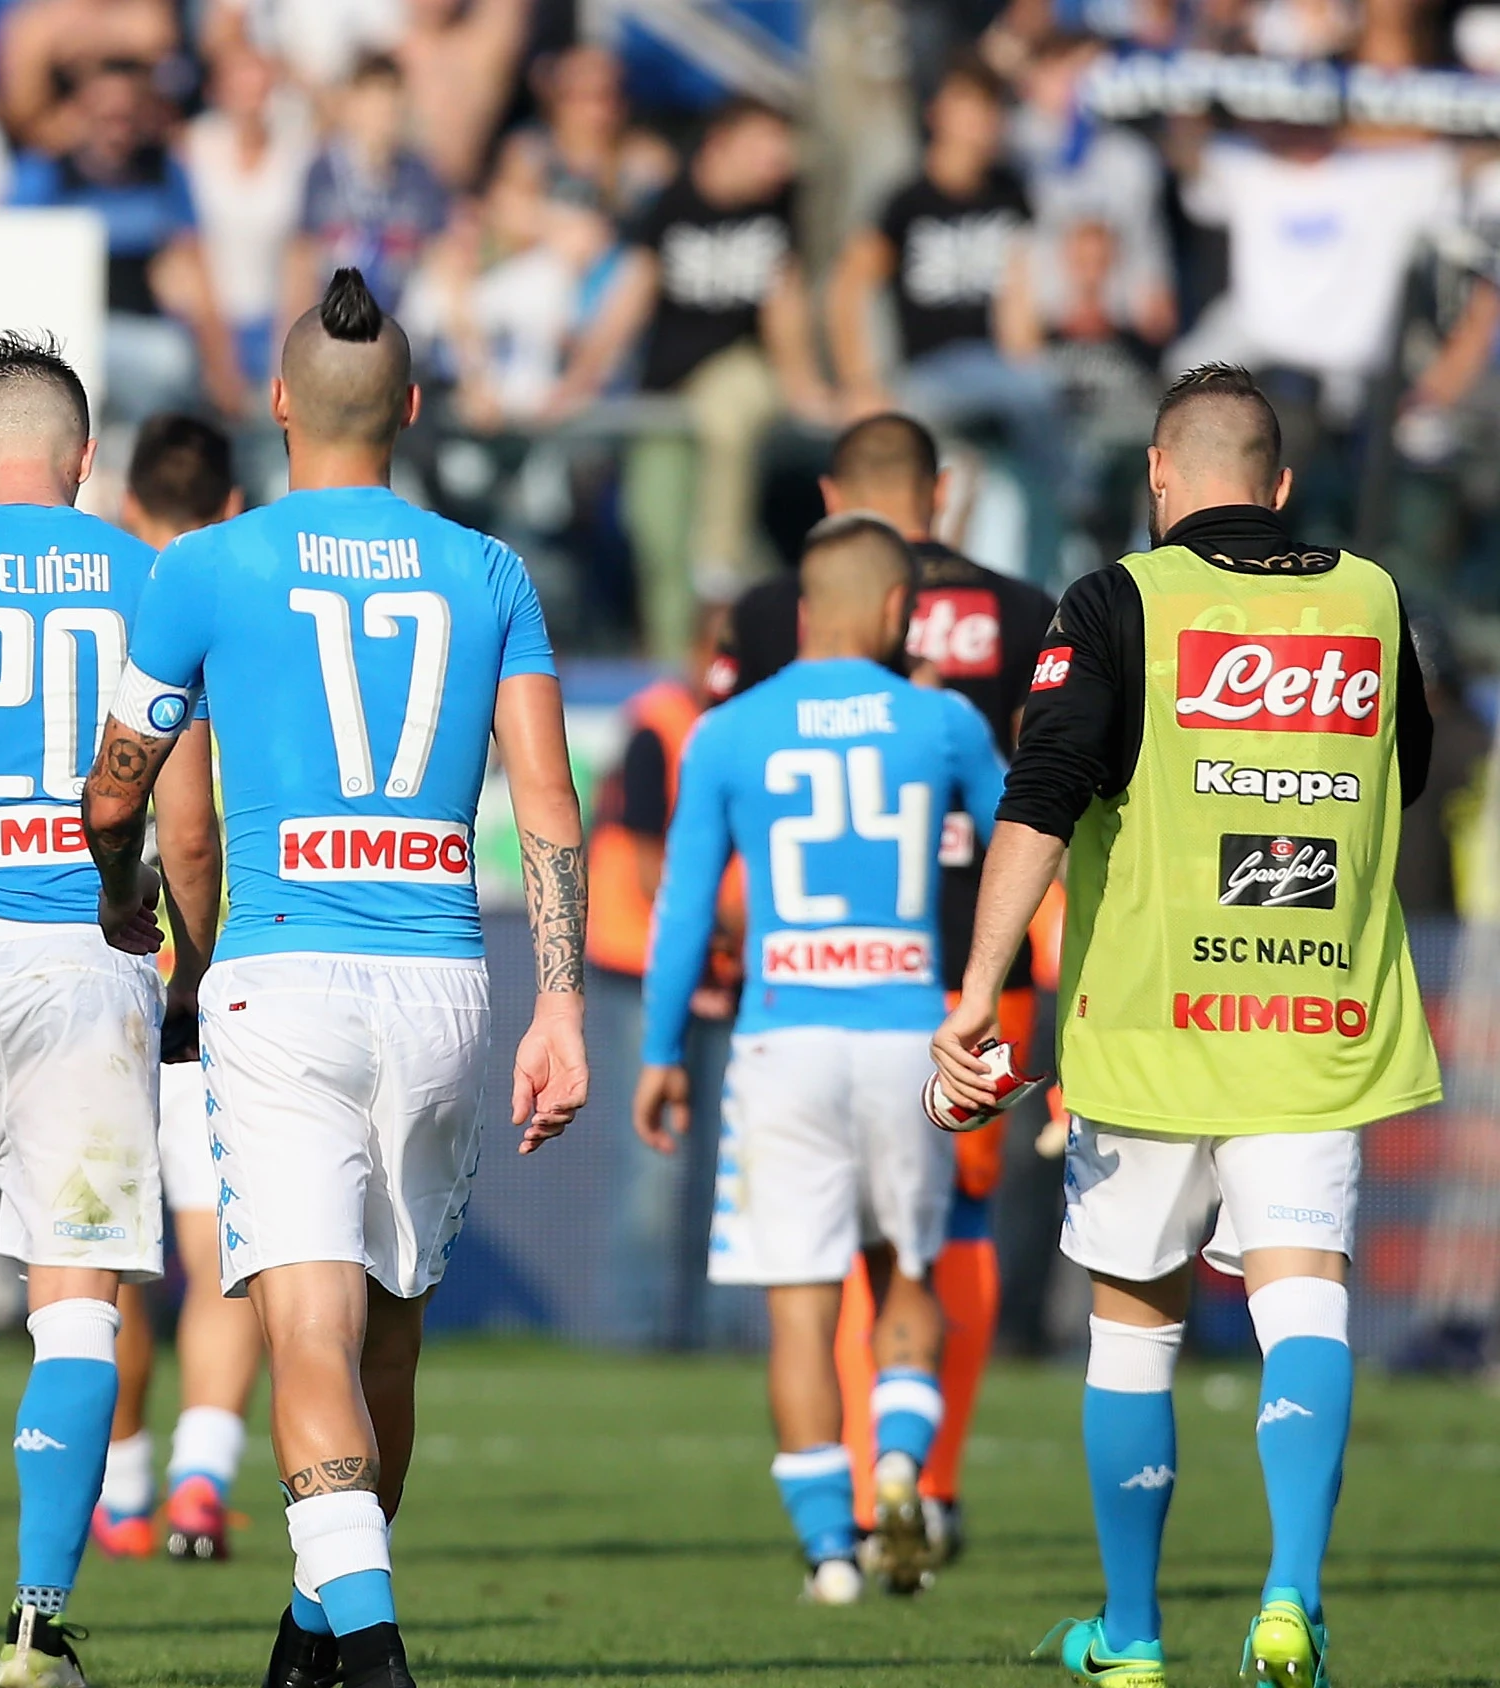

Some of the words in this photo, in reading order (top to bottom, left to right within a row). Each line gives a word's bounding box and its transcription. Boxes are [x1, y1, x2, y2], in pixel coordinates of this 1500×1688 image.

[297, 531, 422, 579] HAMSIK
[289, 587, 451, 798] 17
[1176, 644, 1381, 721] Lete
[1195, 759, 1360, 804] Kappa
[284, 829, 469, 875] KIMBO
[764, 746, 931, 923] 24
[766, 940, 928, 973] KIMBO
[1193, 936, 1248, 963] SSC
[1172, 992, 1367, 1038] KIMBO
[53, 1221, 126, 1241] Kappa
[1267, 1205, 1335, 1224] Kappa
